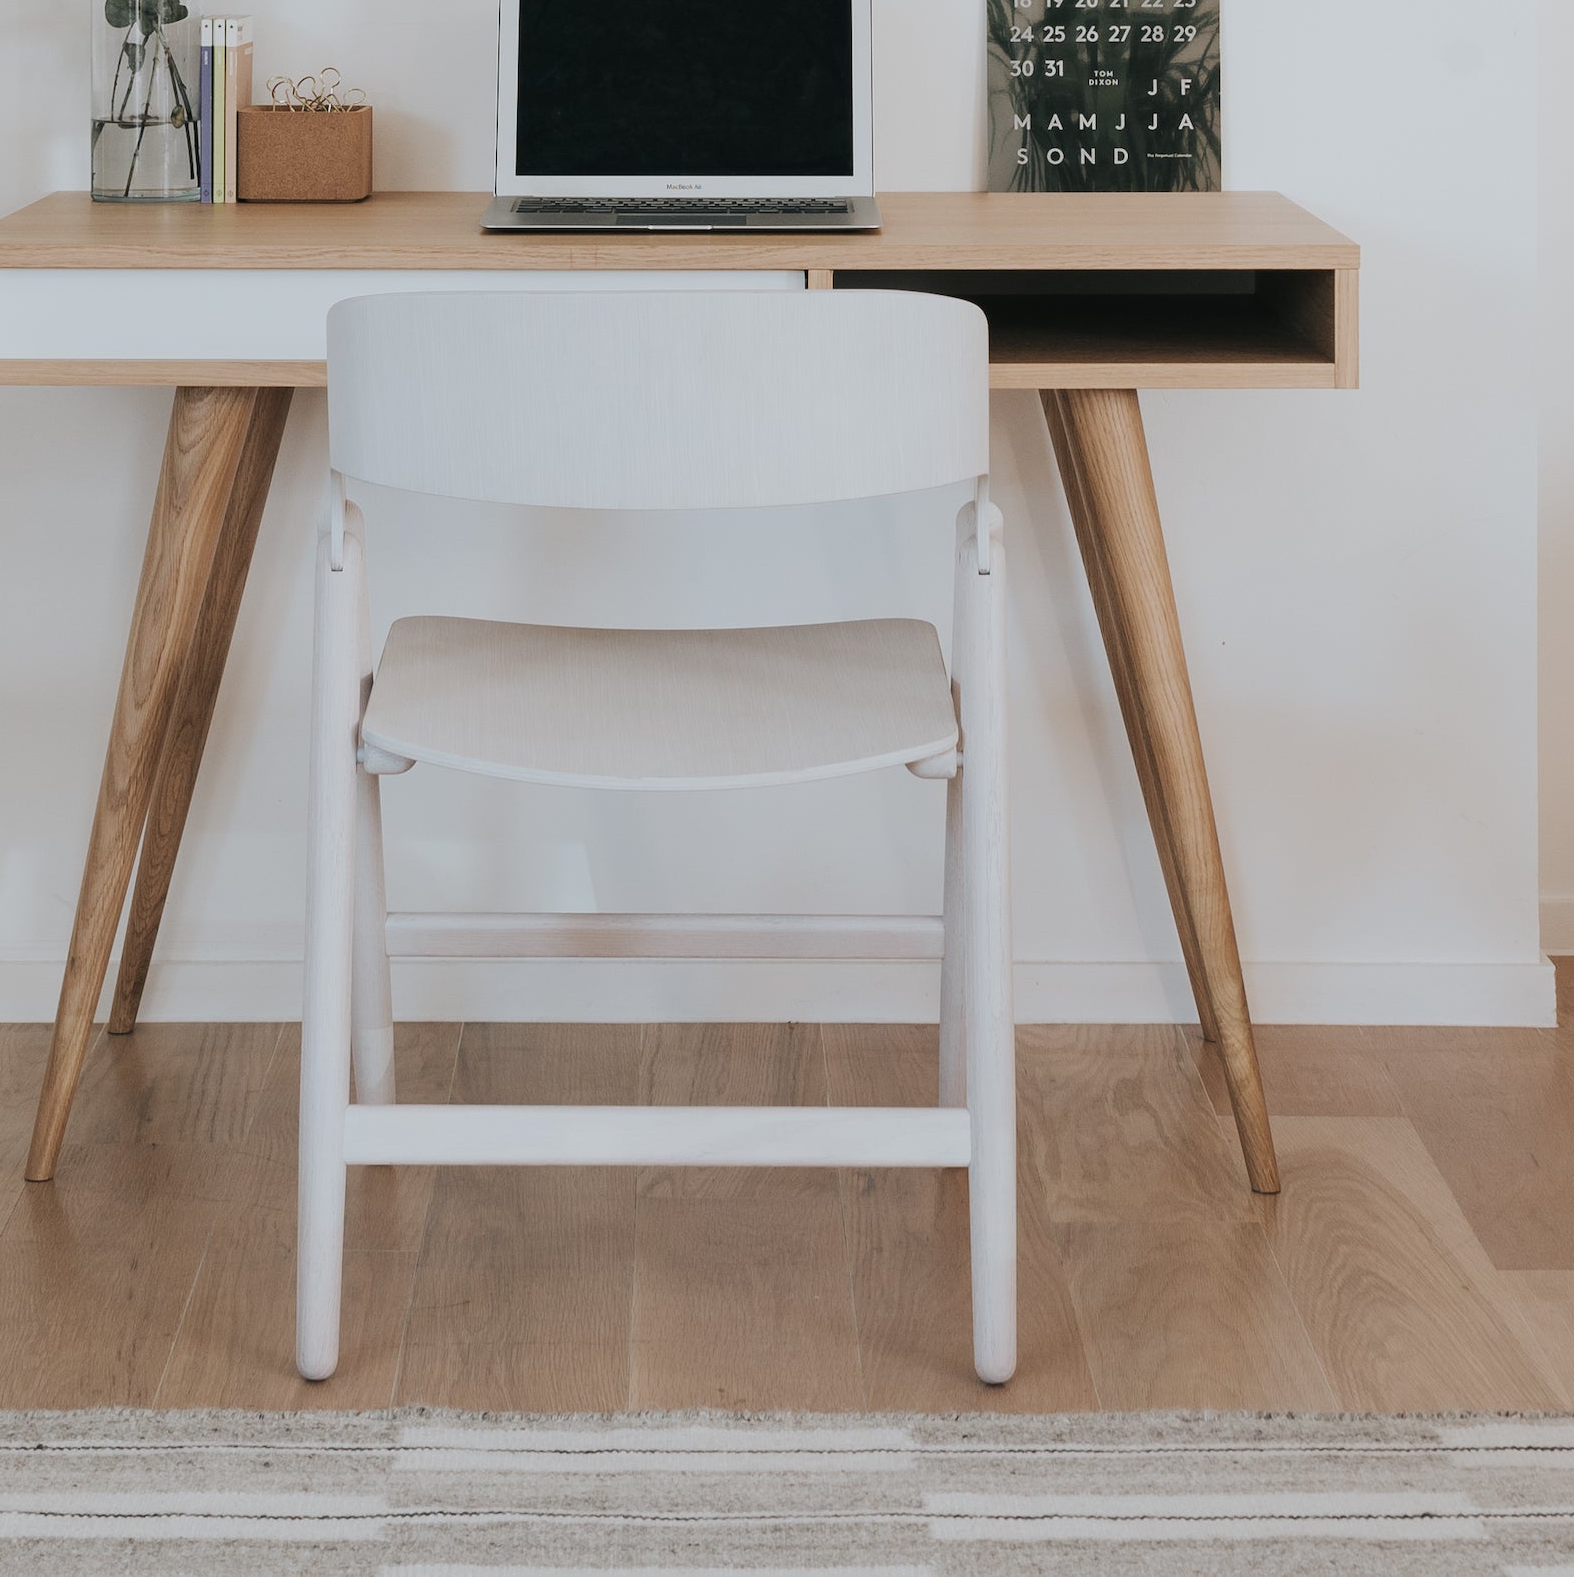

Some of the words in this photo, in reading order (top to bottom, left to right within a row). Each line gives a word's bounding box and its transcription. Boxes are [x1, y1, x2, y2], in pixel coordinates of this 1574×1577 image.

[1009, 25, 1035, 43] 24
[1042, 25, 1066, 43] 25
[1075, 25, 1099, 43] 26
[1108, 25, 1131, 43] 27
[1140, 25, 1165, 43] 28
[1173, 25, 1197, 43] 29
[1009, 60, 1035, 77] 30
[1044, 60, 1065, 77] 31
[1093, 70, 1114, 78] TOM
[1088, 78, 1119, 86] DIXON
[1147, 78, 1158, 96] J
[1180, 78, 1193, 96] F
[1013, 113, 1031, 131] M
[1047, 113, 1064, 131] A
[1078, 113, 1097, 131] M
[1114, 113, 1126, 131] J
[1147, 113, 1159, 131] J
[1177, 113, 1195, 131] A
[1016, 147, 1029, 166] S
[1046, 147, 1065, 166] O
[1080, 147, 1097, 166] N
[1112, 147, 1129, 166] D
